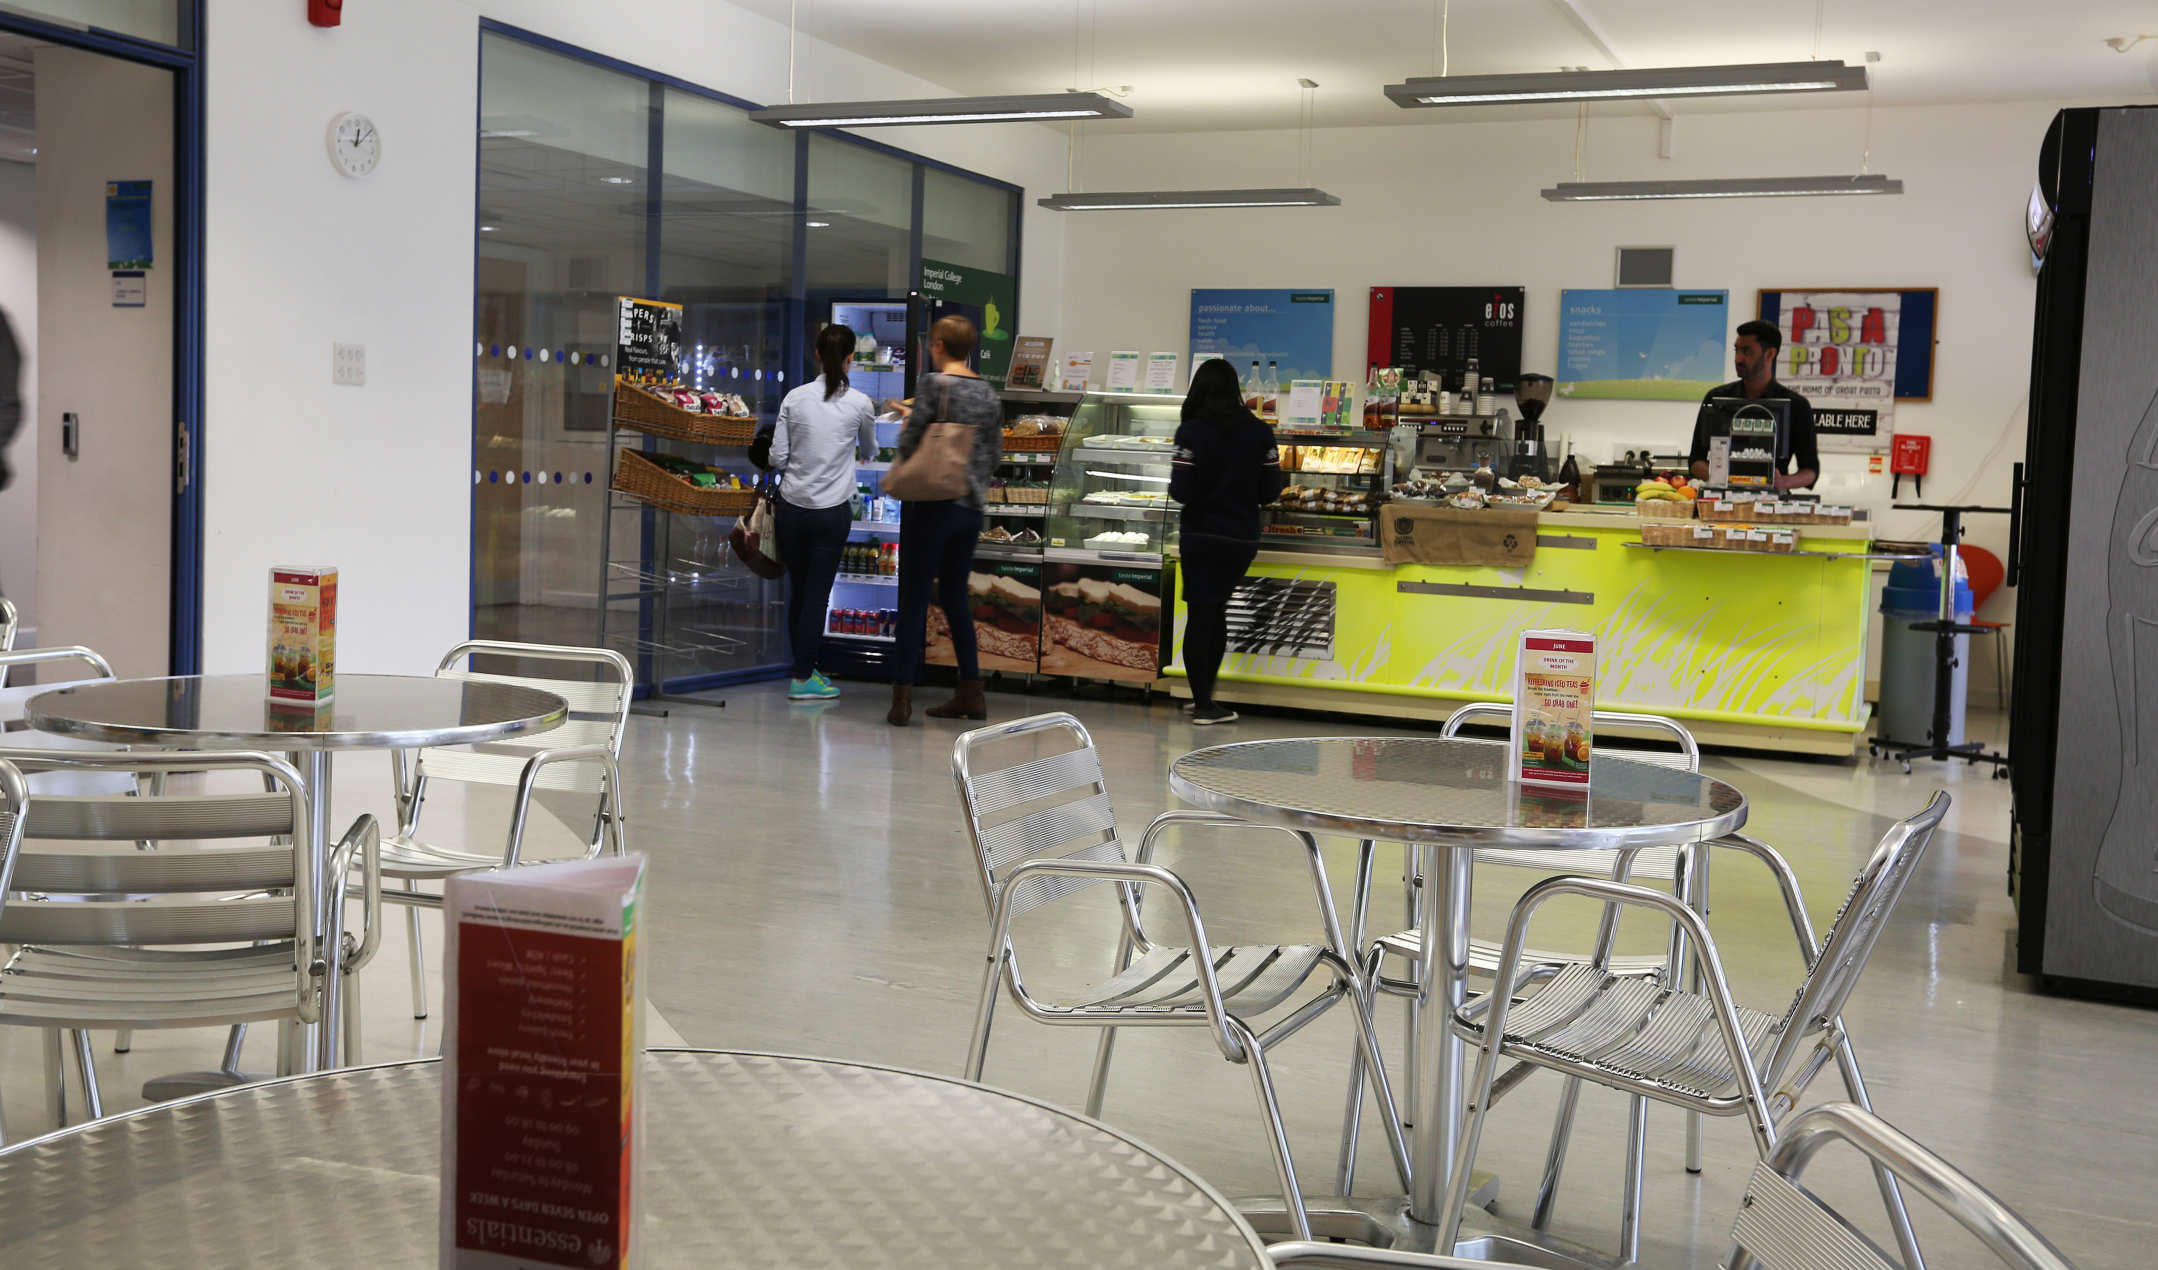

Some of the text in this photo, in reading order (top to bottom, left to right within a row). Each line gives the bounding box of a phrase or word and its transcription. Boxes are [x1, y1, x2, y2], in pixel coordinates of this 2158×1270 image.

[923, 279, 944, 291] London
[924, 266, 962, 286] Imperial College
[1198, 303, 1242, 313] passionate
[1570, 304, 1602, 315] snacks
[1484, 319, 1514, 328] coffee
[1791, 305, 1886, 345] PASTA
[1788, 345, 1886, 377] PRONTO
[1813, 413, 1871, 428] LABLE HERE
[522, 1134, 560, 1153] Sunday
[490, 1164, 593, 1195] Monday to Saturday
[469, 1191, 609, 1225] OPEN SEVEN DAYS A WEEK
[466, 1216, 582, 1253] essentials
